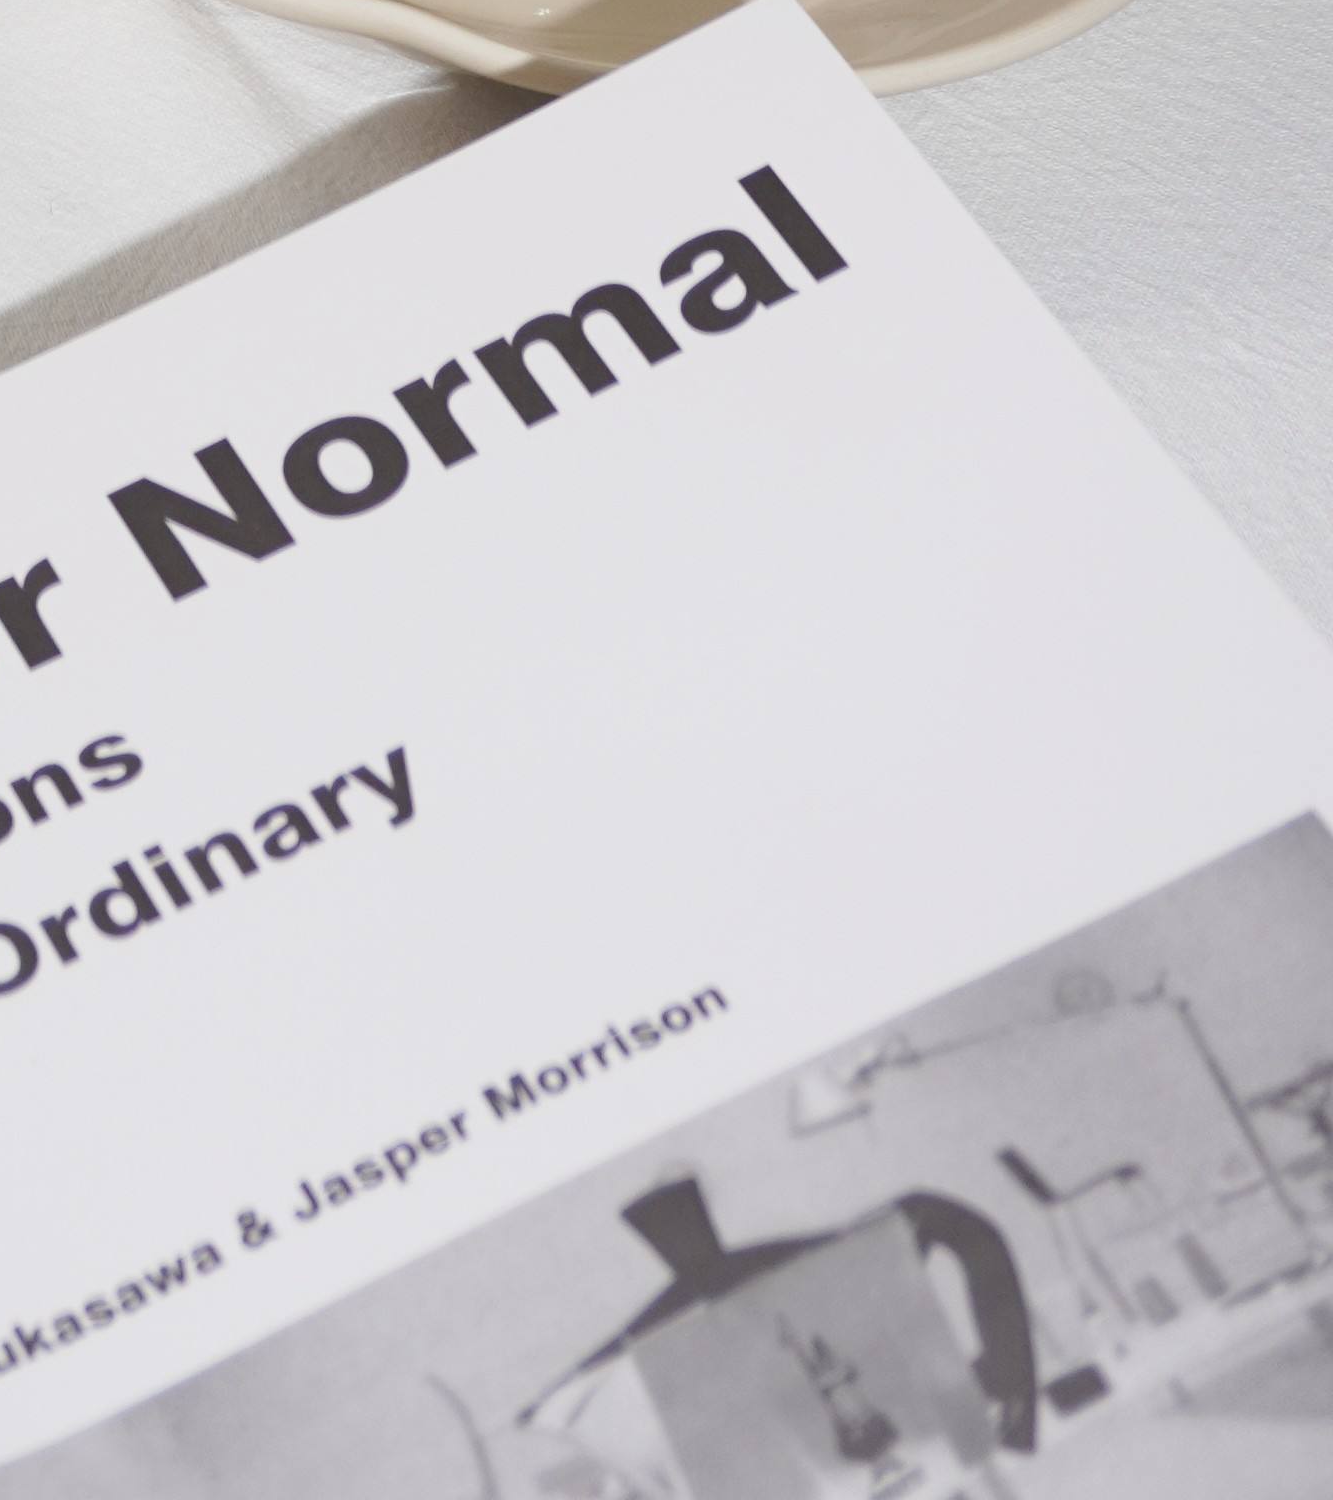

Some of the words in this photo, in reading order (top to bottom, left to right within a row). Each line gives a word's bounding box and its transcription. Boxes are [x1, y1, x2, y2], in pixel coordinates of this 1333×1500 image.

[107, 165, 848, 601] Normal
[236, 1208, 274, 1250] &
[296, 1115, 464, 1218] Jasper
[483, 989, 726, 1118] Morrison
